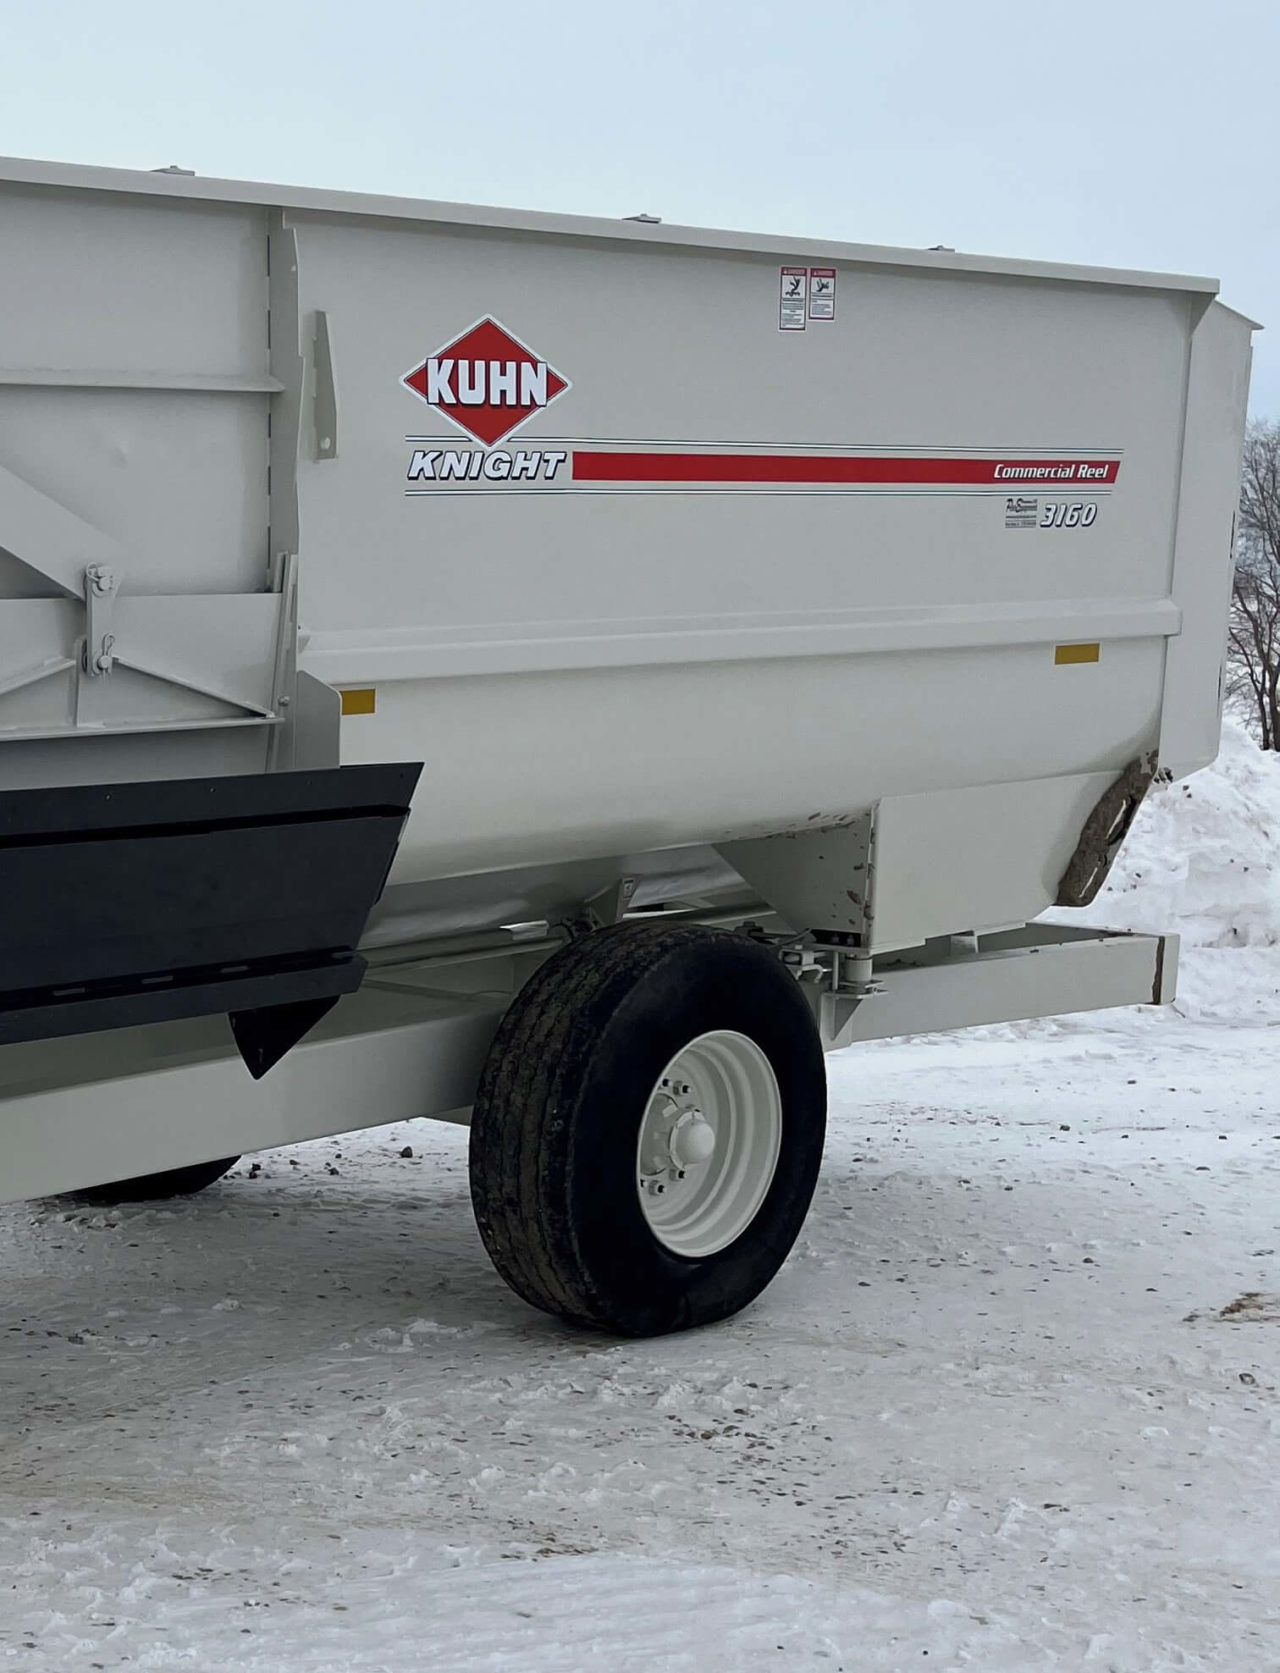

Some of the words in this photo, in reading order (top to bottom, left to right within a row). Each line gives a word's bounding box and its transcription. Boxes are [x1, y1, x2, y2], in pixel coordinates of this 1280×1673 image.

[426, 357, 548, 407] KUHN
[407, 450, 568, 480] KNIGHT
[994, 463, 1076, 479] Commercial
[1077, 464, 1109, 479] Reel
[1040, 503, 1097, 528] 3160
